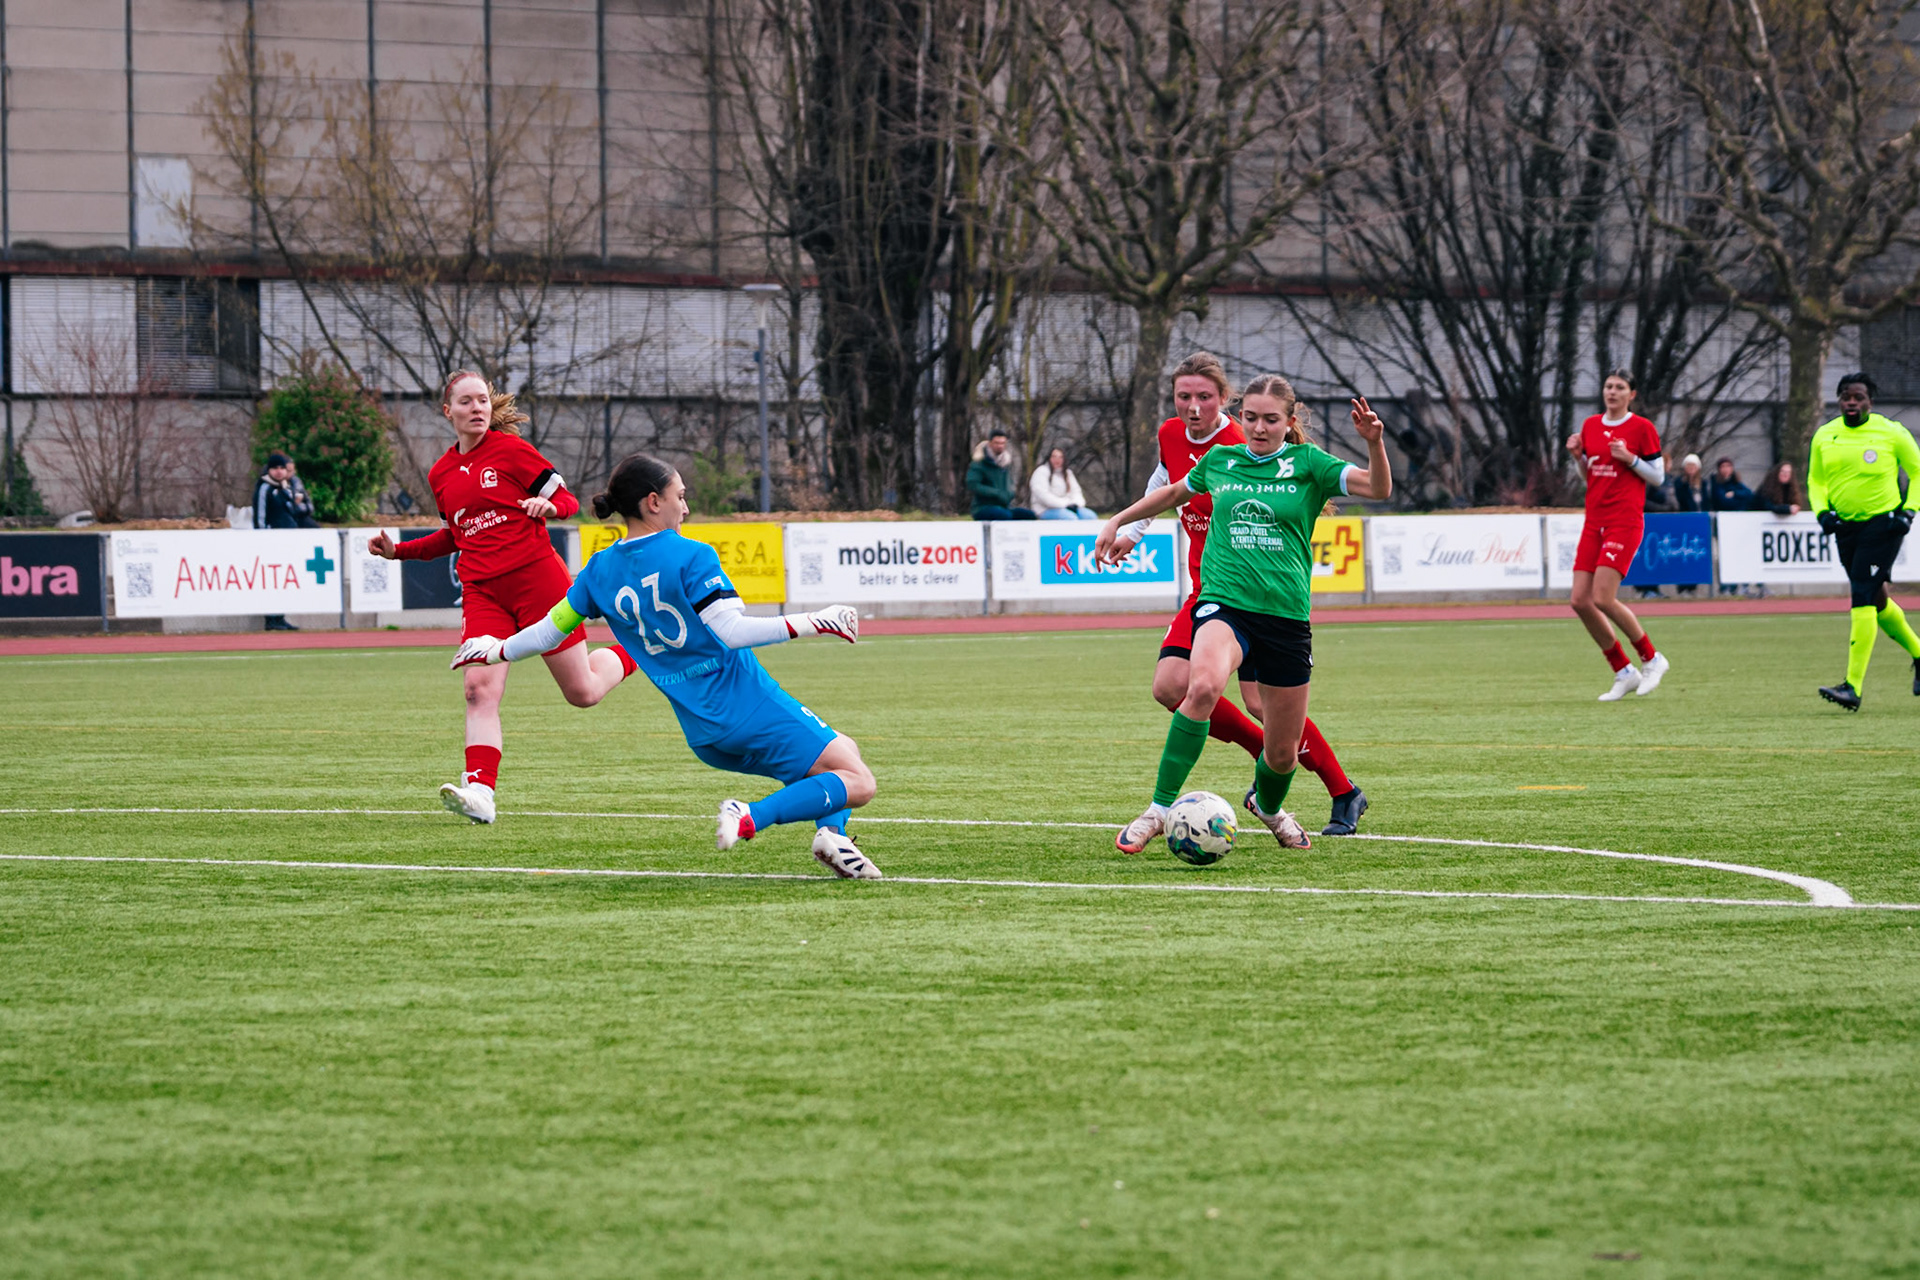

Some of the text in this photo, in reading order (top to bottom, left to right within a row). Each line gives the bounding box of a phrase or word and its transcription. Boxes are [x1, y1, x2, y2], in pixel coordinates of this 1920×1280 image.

[838, 540, 978, 566] mobilezone
[1416, 533, 1530, 566] Luna Park
[1762, 531, 1831, 562] BOXER
[0, 557, 80, 596] bra
[859, 571, 960, 585] better be clever
[614, 572, 688, 655] 23
